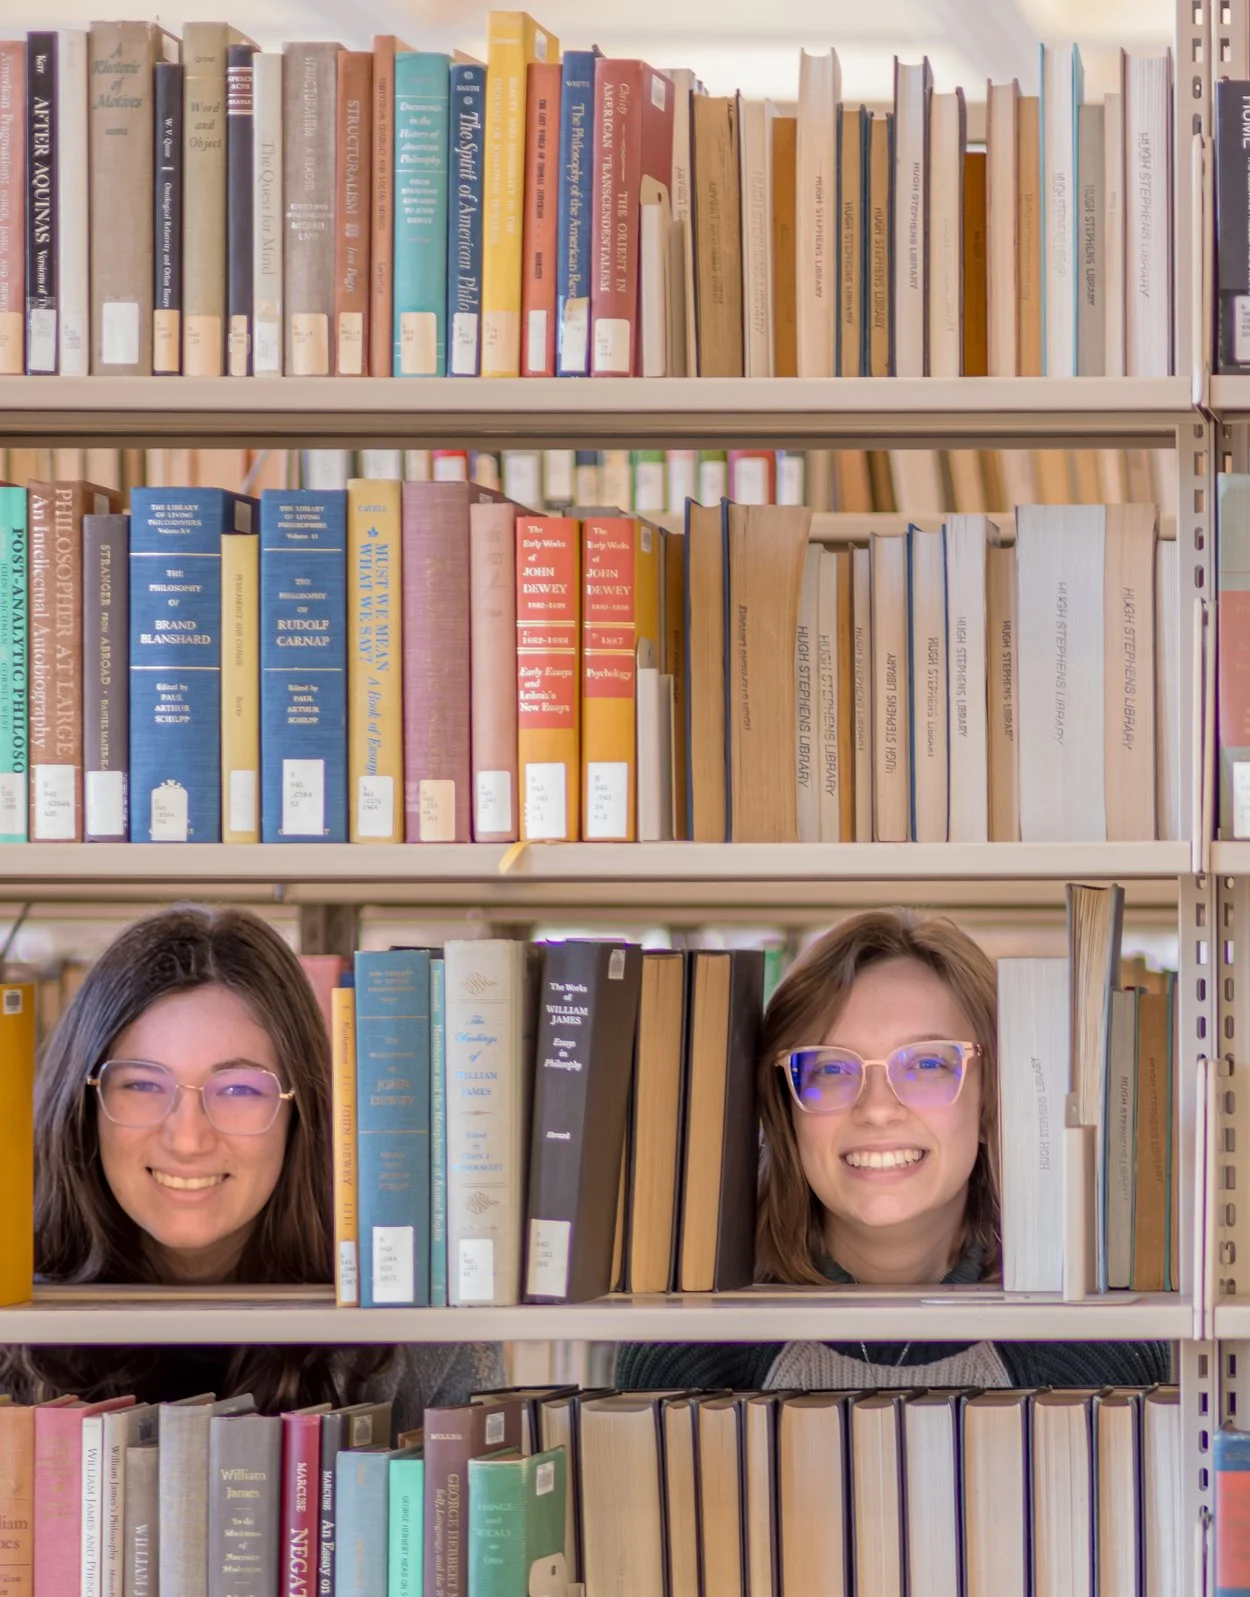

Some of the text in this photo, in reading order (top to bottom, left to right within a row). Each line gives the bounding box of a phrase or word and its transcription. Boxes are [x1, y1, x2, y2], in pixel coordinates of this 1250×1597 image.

[35, 55, 47, 74] Kerr
[32, 97, 49, 245] AFTER AQUINAS
[600, 82, 613, 292] AMERICAN TRANSCENDENTALISM
[522, 566, 555, 577] JOHN
[523, 583, 568, 594] DEWEY
[358, 543, 372, 664] WHAT WE SAY?
[374, 543, 389, 672] MUST WE MEAN
[32, 494, 50, 749] An Intellectual Autobiography
[56, 488, 74, 756] PHILOSOPHER AT LARGE
[155, 619, 196, 631] BRAND
[277, 619, 329, 631] RUDOLF
[140, 633, 211, 646] BLANSHARD
[276, 635, 330, 647] CARNAP
[1124, 587, 1134, 751] HUGH STEPHENS LIBRARY
[546, 1006, 589, 1017] WILLIAM
[550, 1015, 582, 1026] JAMES
[220, 1468, 266, 1481] William
[225, 1487, 260, 1500] James
[296, 1462, 307, 1513] MARCUSE
[449, 1473, 460, 1528] GEORGE
[322, 1520, 335, 1540] An
[134, 1524, 148, 1586] WILLIAM
[319, 1542, 335, 1577] Essay
[448, 1531, 460, 1590] HERBERT
[321, 1579, 331, 1595] on
